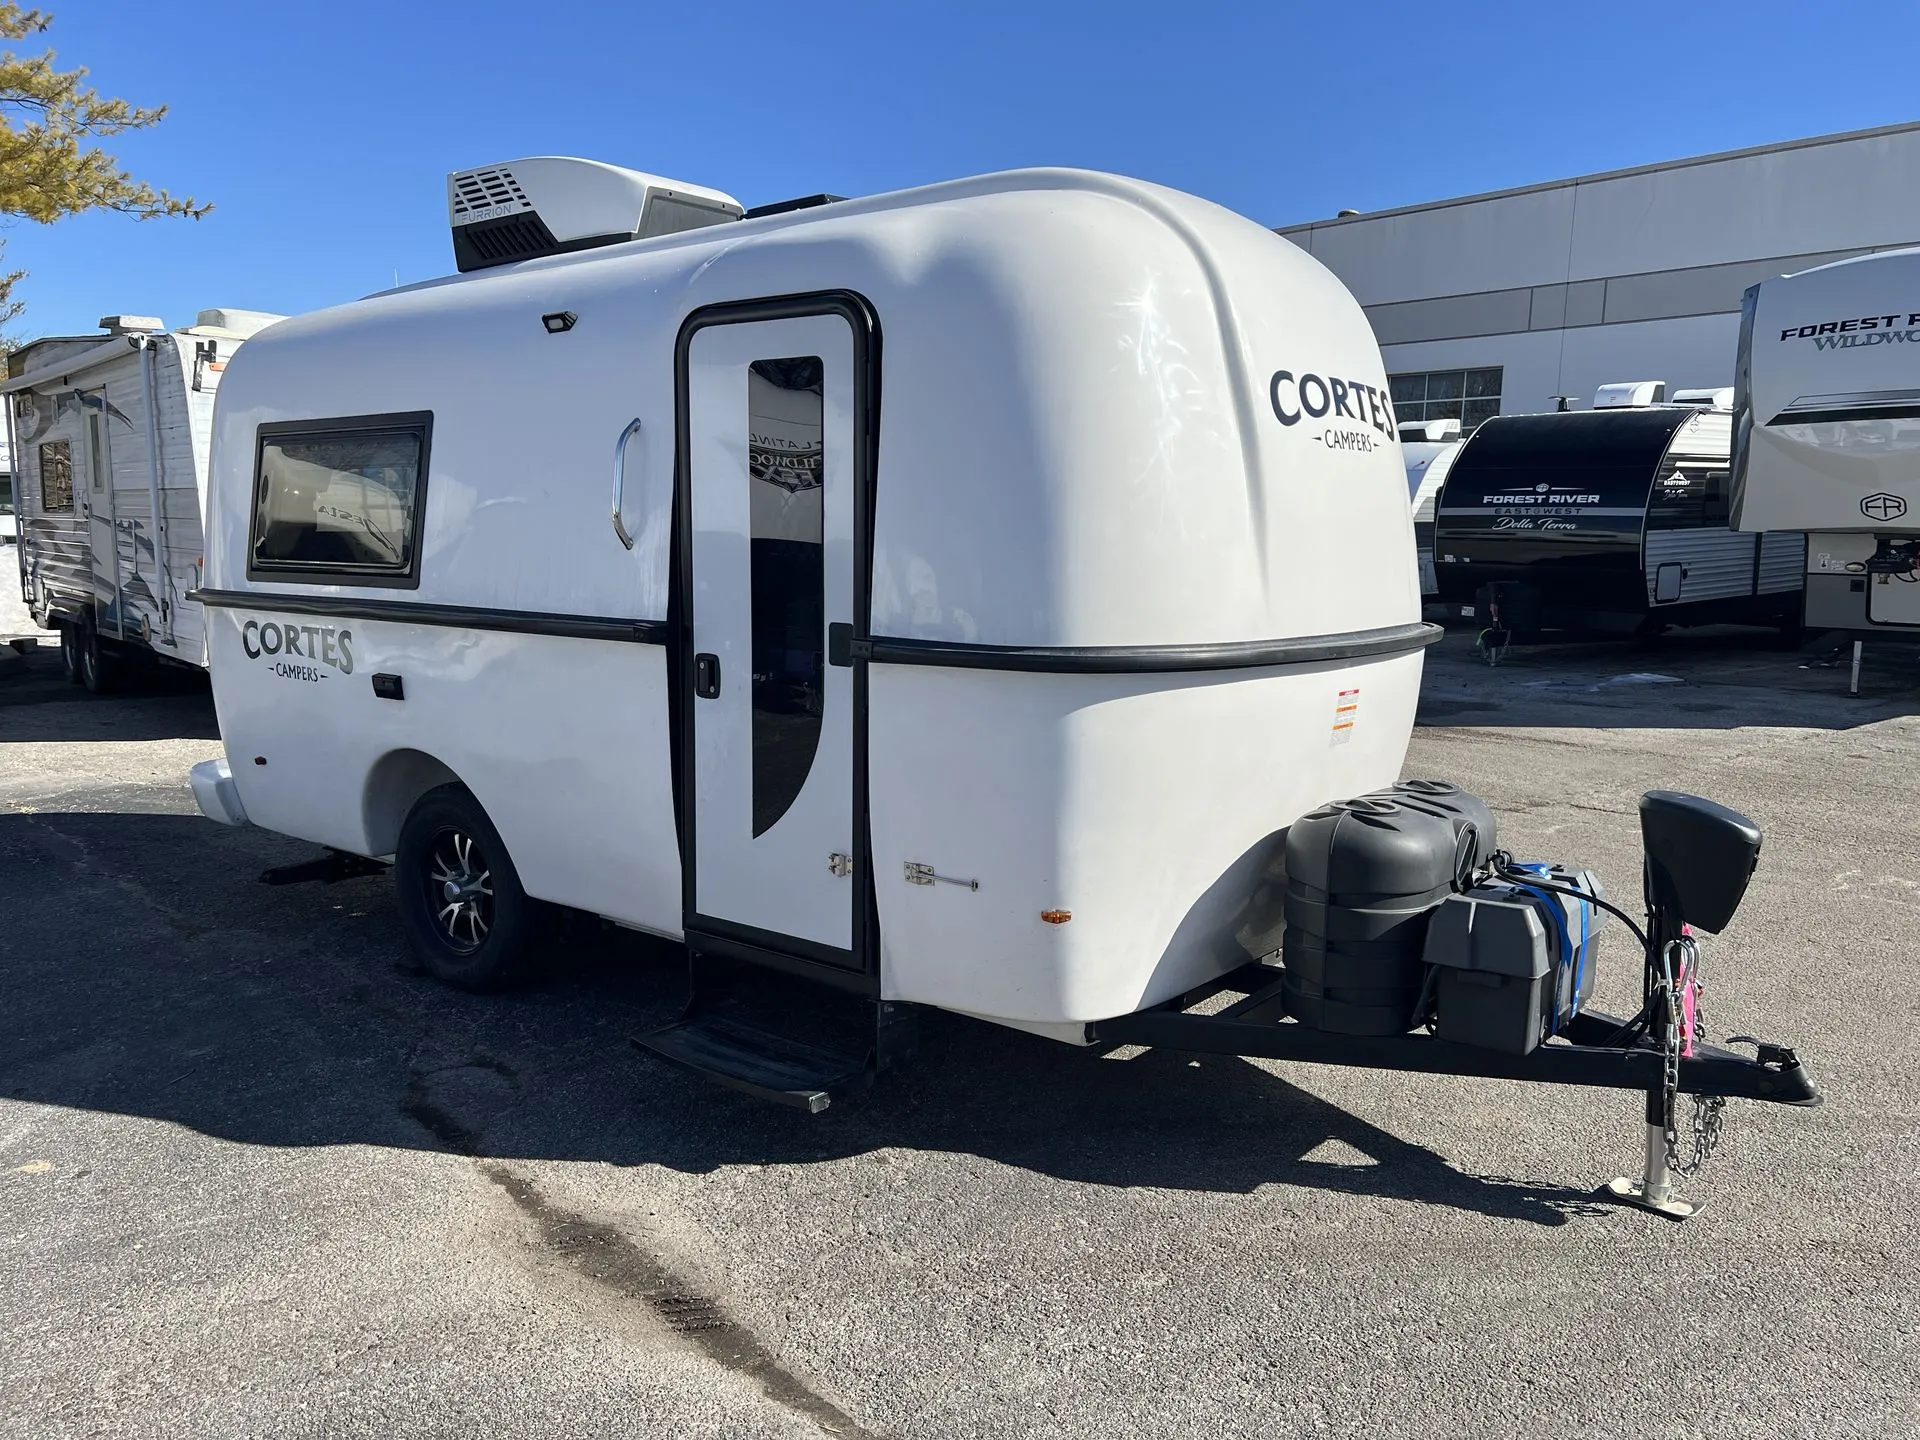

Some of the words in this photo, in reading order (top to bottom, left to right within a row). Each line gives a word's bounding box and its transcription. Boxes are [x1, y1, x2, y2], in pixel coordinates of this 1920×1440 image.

[461, 204, 512, 223] FURRION
[1781, 315, 1901, 342] FOREST
[1270, 370, 1395, 442] CORTES
[1325, 429, 1372, 452] CAMPERS
[1483, 495, 1546, 504] FOREST
[1549, 495, 1600, 504] RIVER
[1492, 516, 1533, 530] Della
[1537, 517, 1578, 531] Terra
[243, 620, 353, 675] CORTES
[276, 662, 318, 682] CAMPERS
